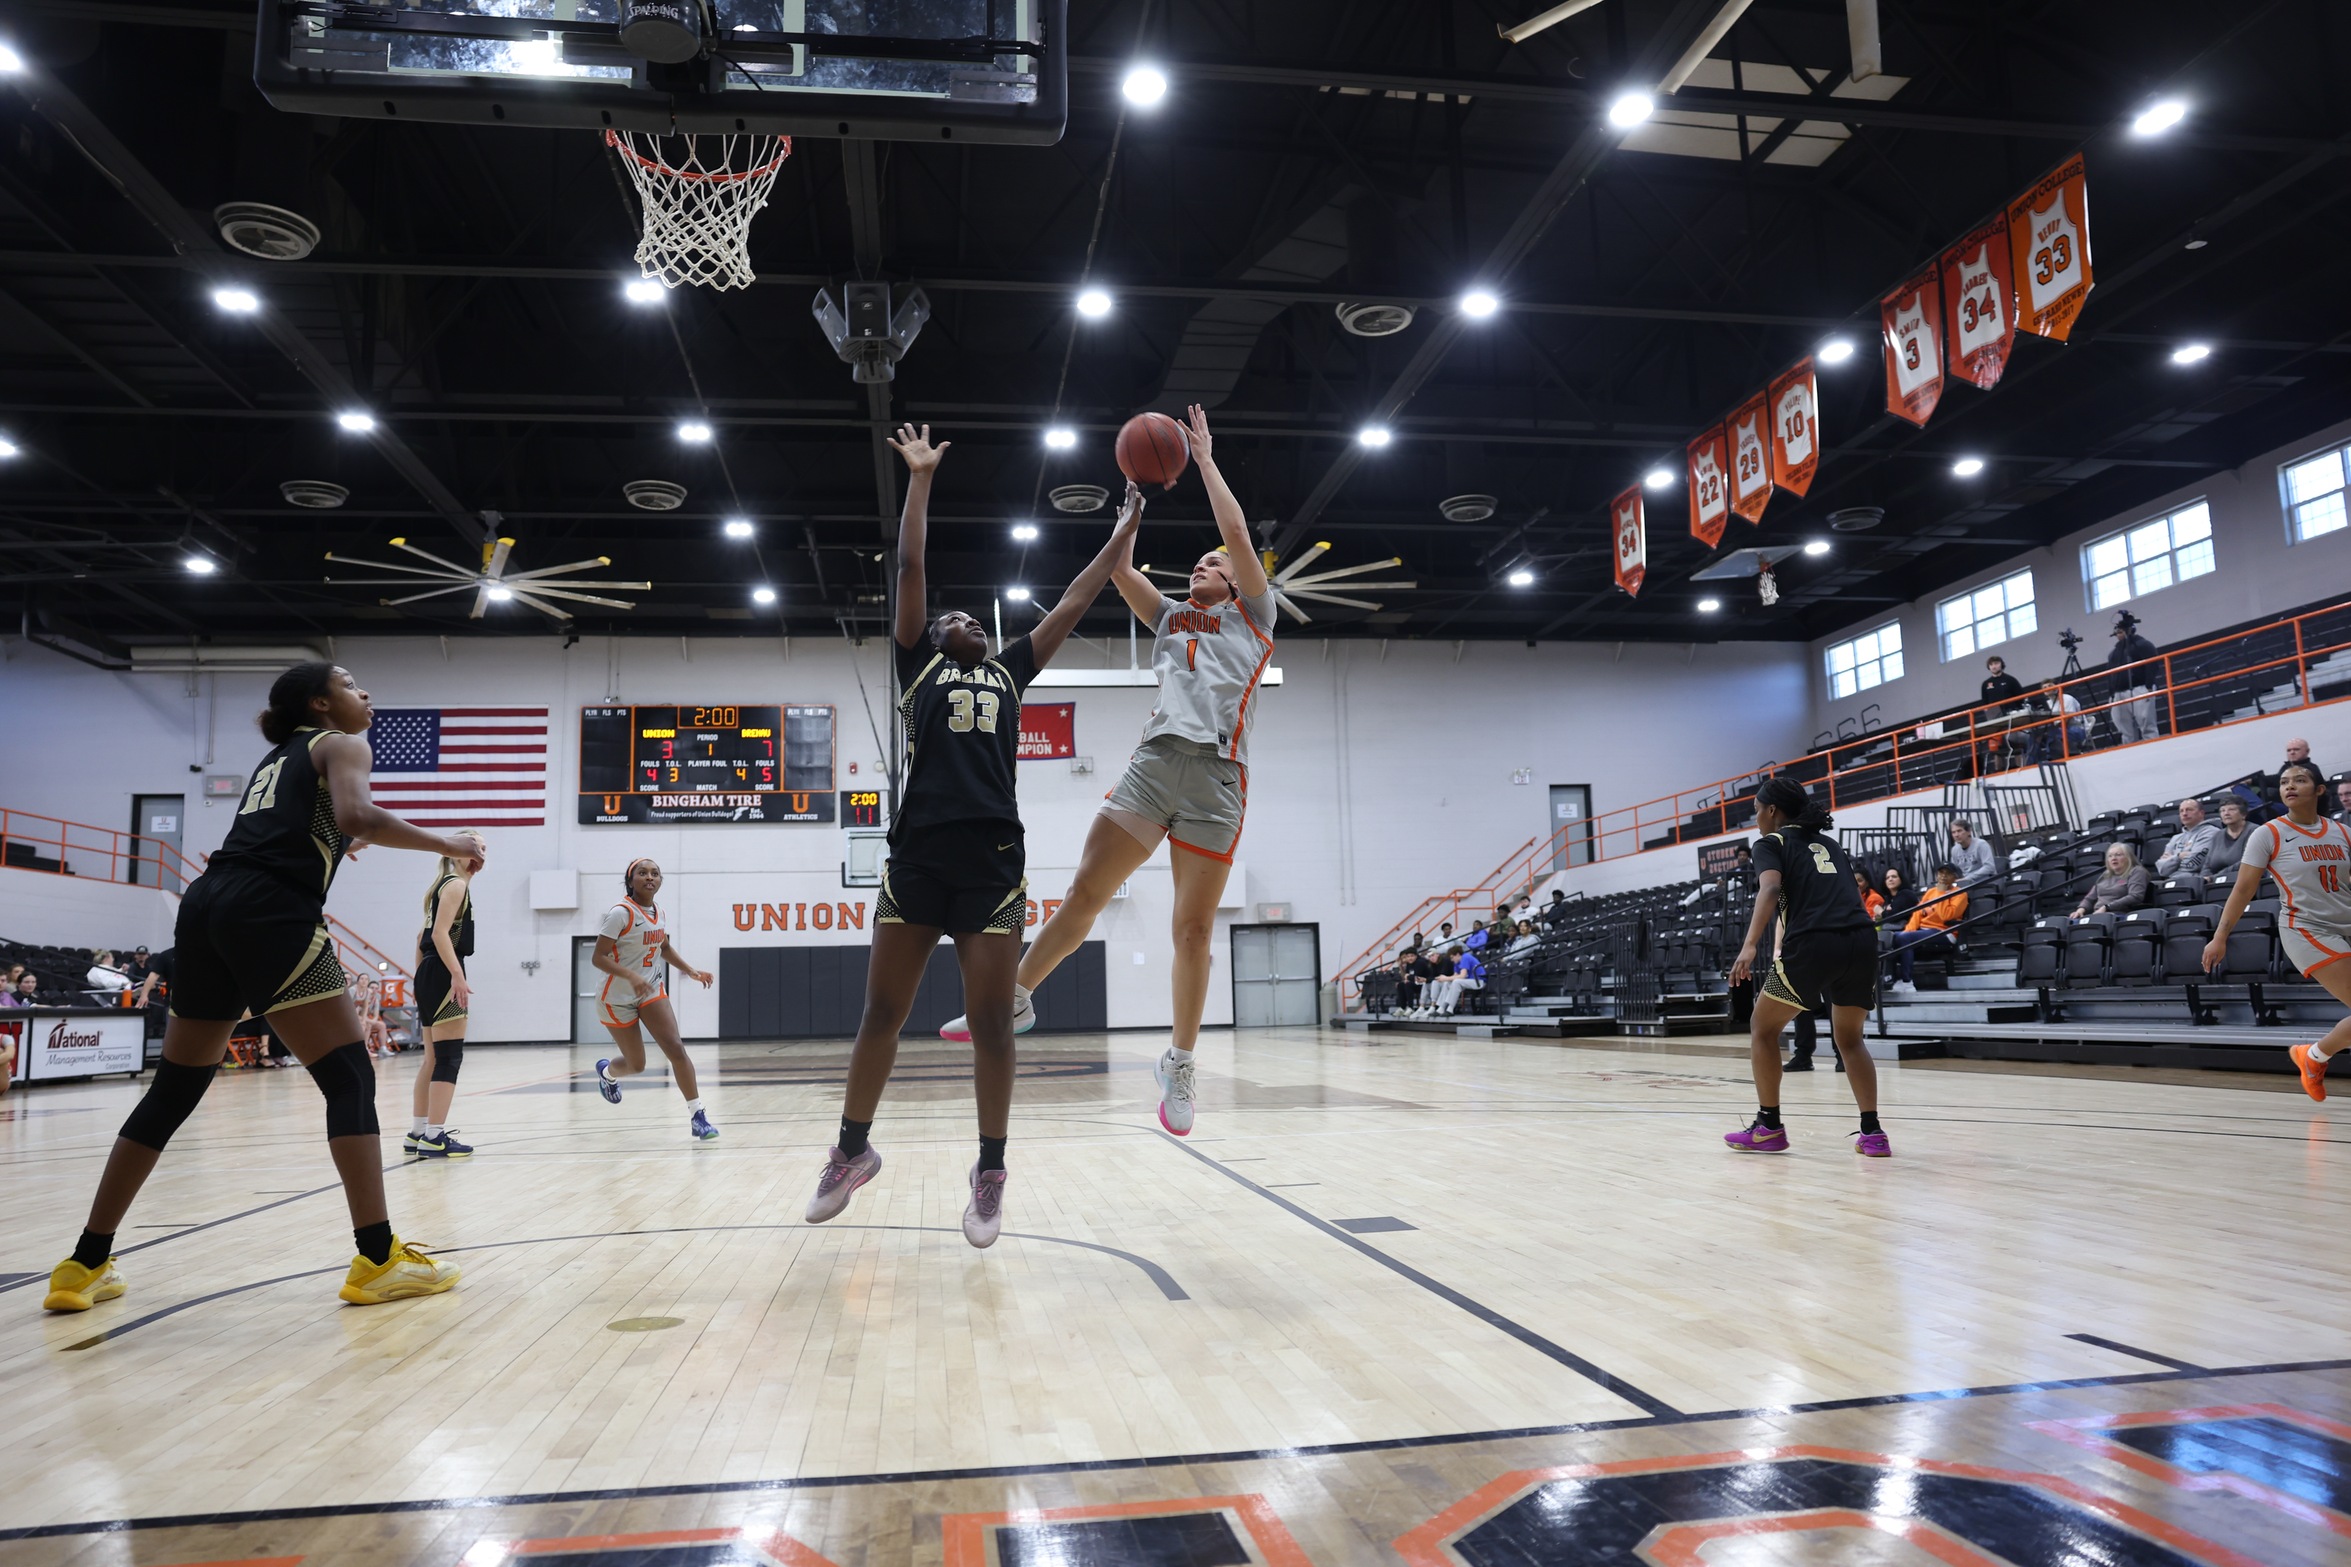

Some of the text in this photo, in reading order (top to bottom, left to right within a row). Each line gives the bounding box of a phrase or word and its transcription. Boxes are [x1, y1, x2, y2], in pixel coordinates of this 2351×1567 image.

[628, 5, 679, 20] SPALDING
[2011, 161, 2083, 223] UNION COLLEGE
[2035, 233, 2072, 285] 33
[1963, 286, 1997, 333] 34
[1906, 336, 1921, 371] 3
[1786, 409, 1805, 444] 10
[1740, 447, 1760, 482] 29
[1701, 475, 1720, 508] 22
[1621, 530, 1637, 558] 34
[1168, 610, 1222, 635] UNION
[1186, 638, 1199, 672] 1
[694, 707, 735, 726] 2:00
[948, 689, 1000, 735] 33
[642, 729, 676, 738] UNION
[662, 740, 674, 759] 3
[708, 743, 713, 756] 1
[762, 739, 773, 757] 7
[640, 760, 660, 768] FOULS
[755, 759, 775, 767] FOULS
[646, 768, 658, 782] 4
[669, 767, 679, 782] 3
[736, 767, 746, 781] 4
[762, 767, 773, 782] 5
[238, 756, 288, 815] 21
[640, 784, 659, 792] SCORE
[755, 783, 774, 791] SCORE
[603, 795, 621, 815] U
[652, 794, 762, 807] BINGHAM TIRE
[792, 793, 810, 813] U
[850, 793, 878, 806] 2:00
[783, 813, 818, 821] ATHLETICS
[856, 807, 873, 825] 11
[1808, 843, 1838, 874] 2
[2298, 844, 2346, 862] UNION
[2318, 865, 2339, 893] 11
[732, 902, 866, 931] UNION
[643, 946, 657, 967] 2
[385, 983, 395, 993] G
[45, 1051, 132, 1066] Management Resources
